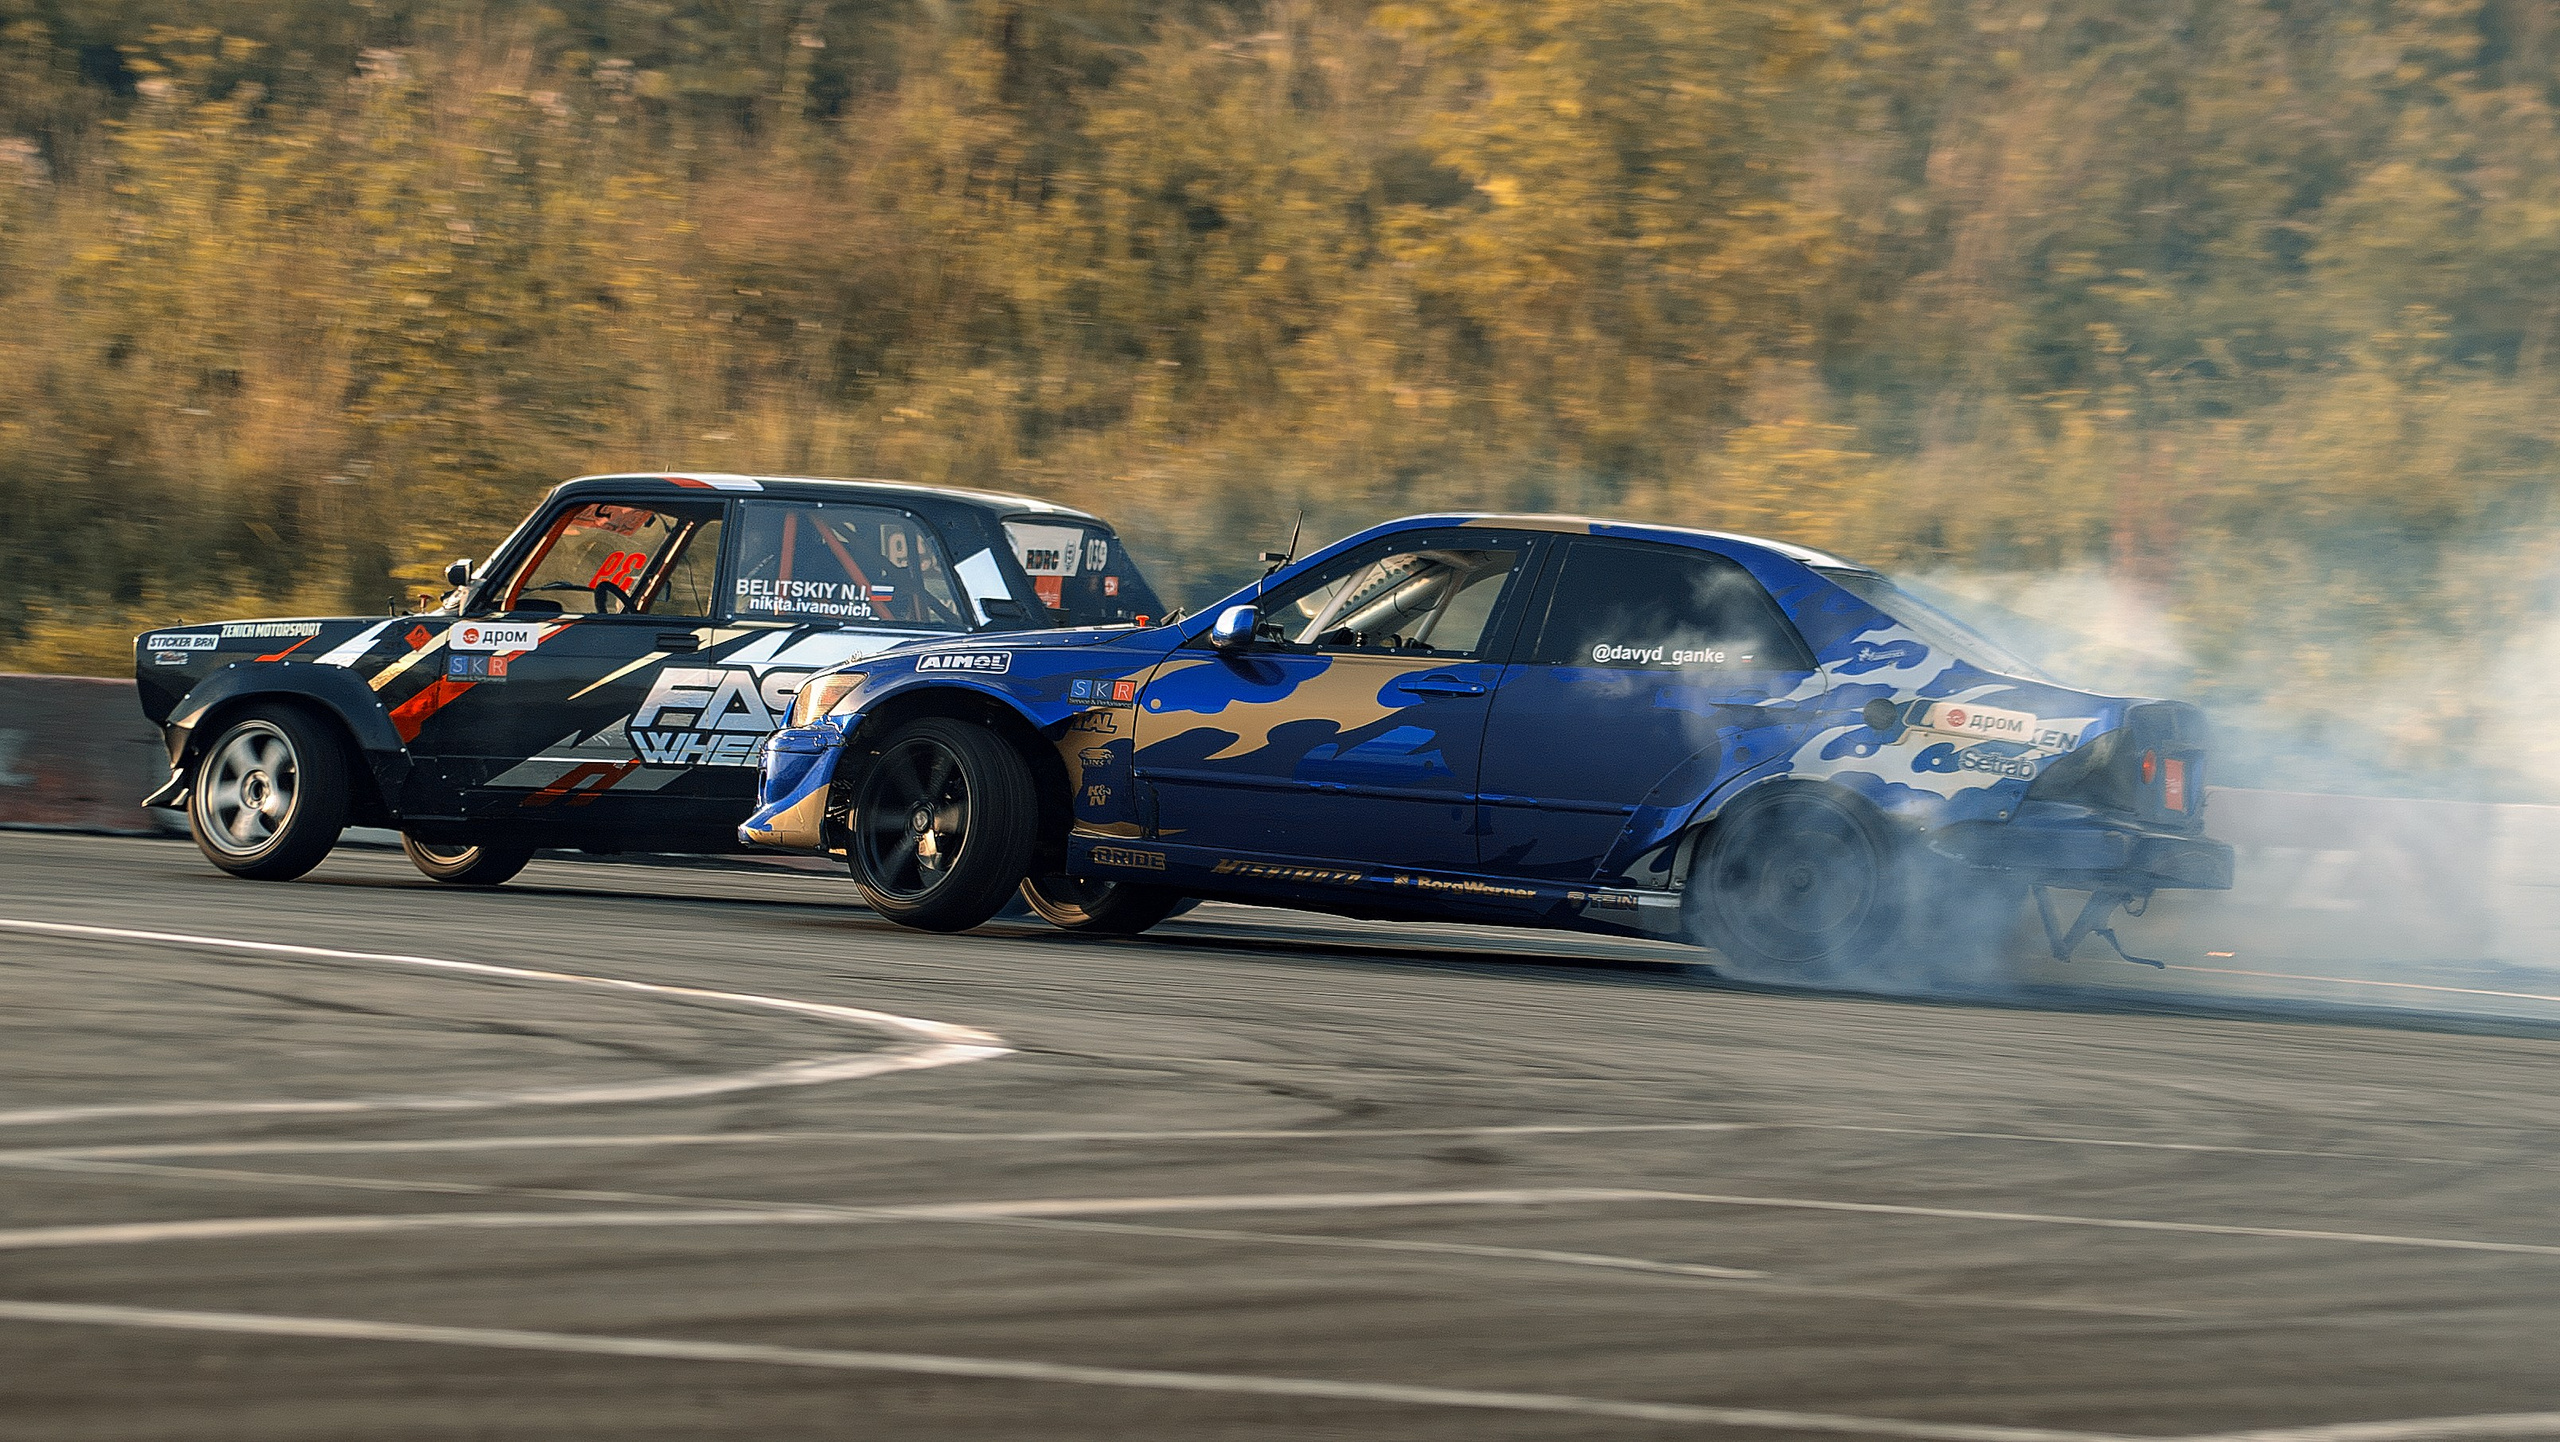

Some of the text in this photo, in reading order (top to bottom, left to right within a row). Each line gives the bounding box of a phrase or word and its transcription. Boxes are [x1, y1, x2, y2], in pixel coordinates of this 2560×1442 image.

[736, 578, 870, 602] BELITSKIY N.I.
[749, 596, 880, 620] nikita.ivanovich_
[221, 622, 323, 638] ZENICH MOTORSPORT
[482, 630, 528, 646] дром
[149, 637, 192, 648] STICKER
[920, 655, 1006, 670] AIMOL
[1592, 643, 1725, 665] @davyd_ganke
[1968, 714, 2023, 733] дром
[1960, 750, 2035, 779] Setrab
[1417, 875, 1538, 899] BorgWarner
